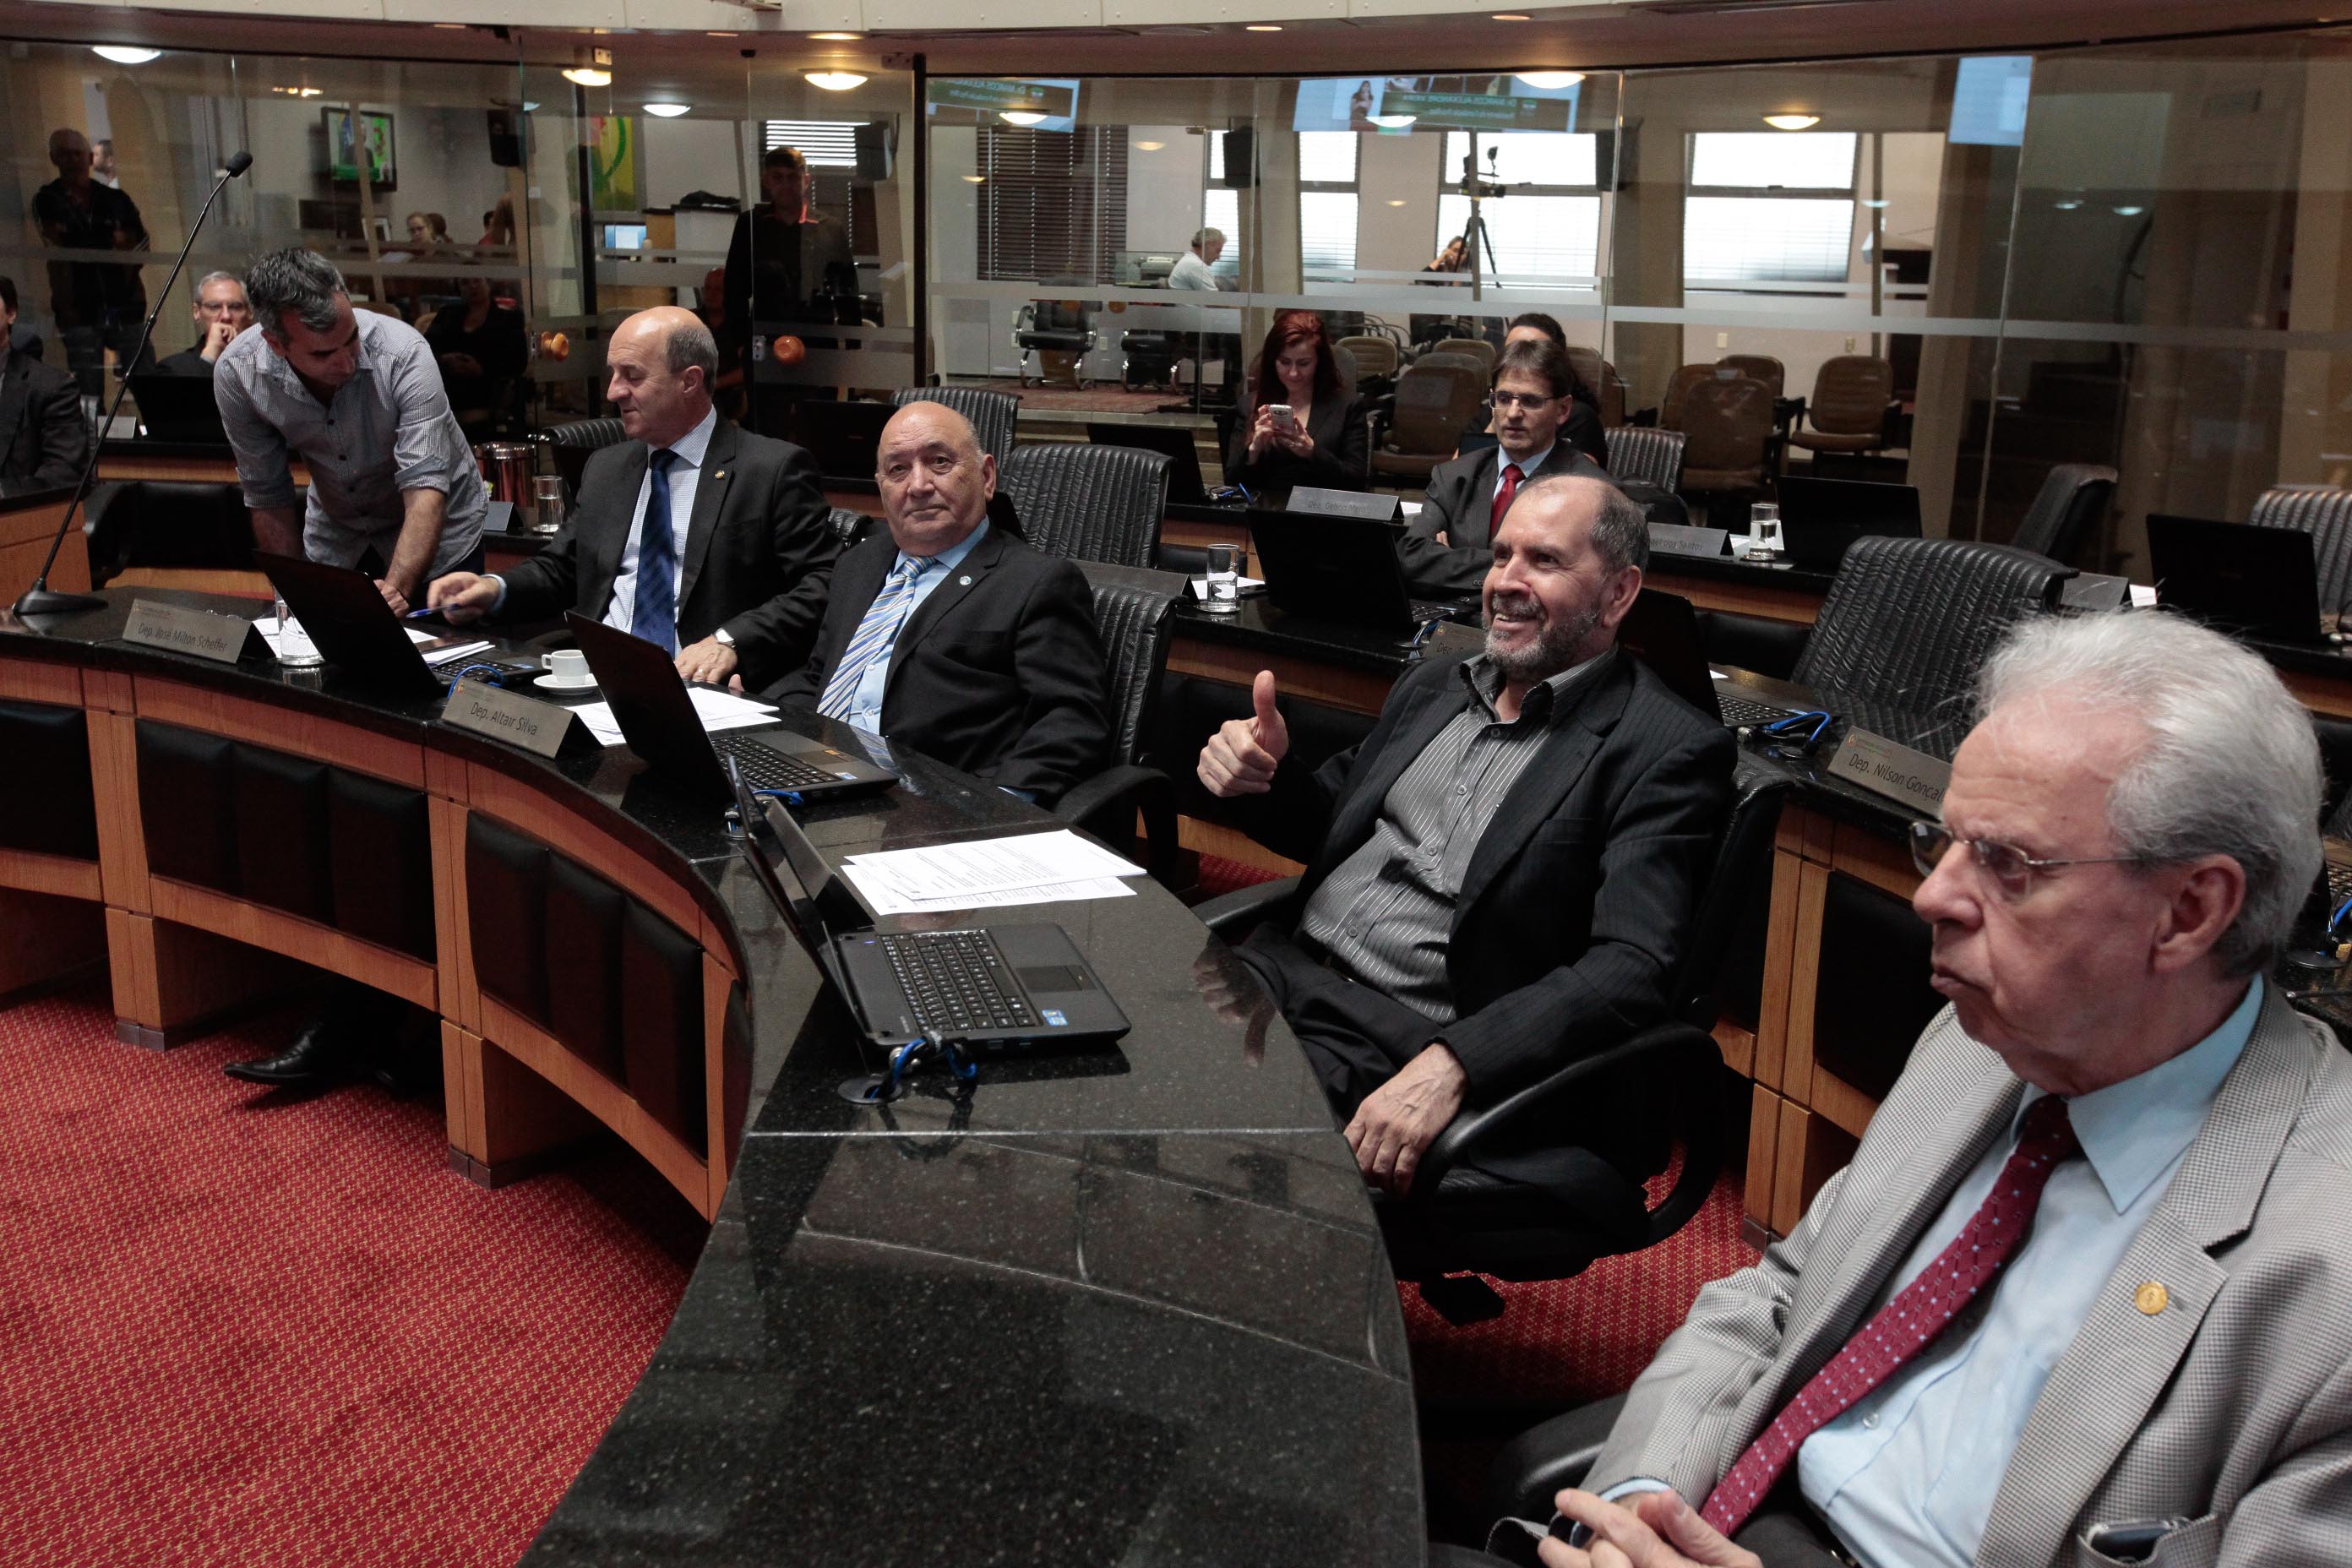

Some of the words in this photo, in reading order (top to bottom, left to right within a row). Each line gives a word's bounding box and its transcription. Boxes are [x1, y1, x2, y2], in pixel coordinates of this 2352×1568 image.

[172, 629, 196, 645] Milton
[197, 634, 228, 652] Scheffer
[470, 701, 488, 721] Dep.
[491, 710, 516, 728] Altair
[515, 716, 538, 736] Silva
[1848, 753, 1870, 773] Dep.
[1873, 763, 1905, 786] Nilson
[1906, 776, 1942, 802] Gonçal
